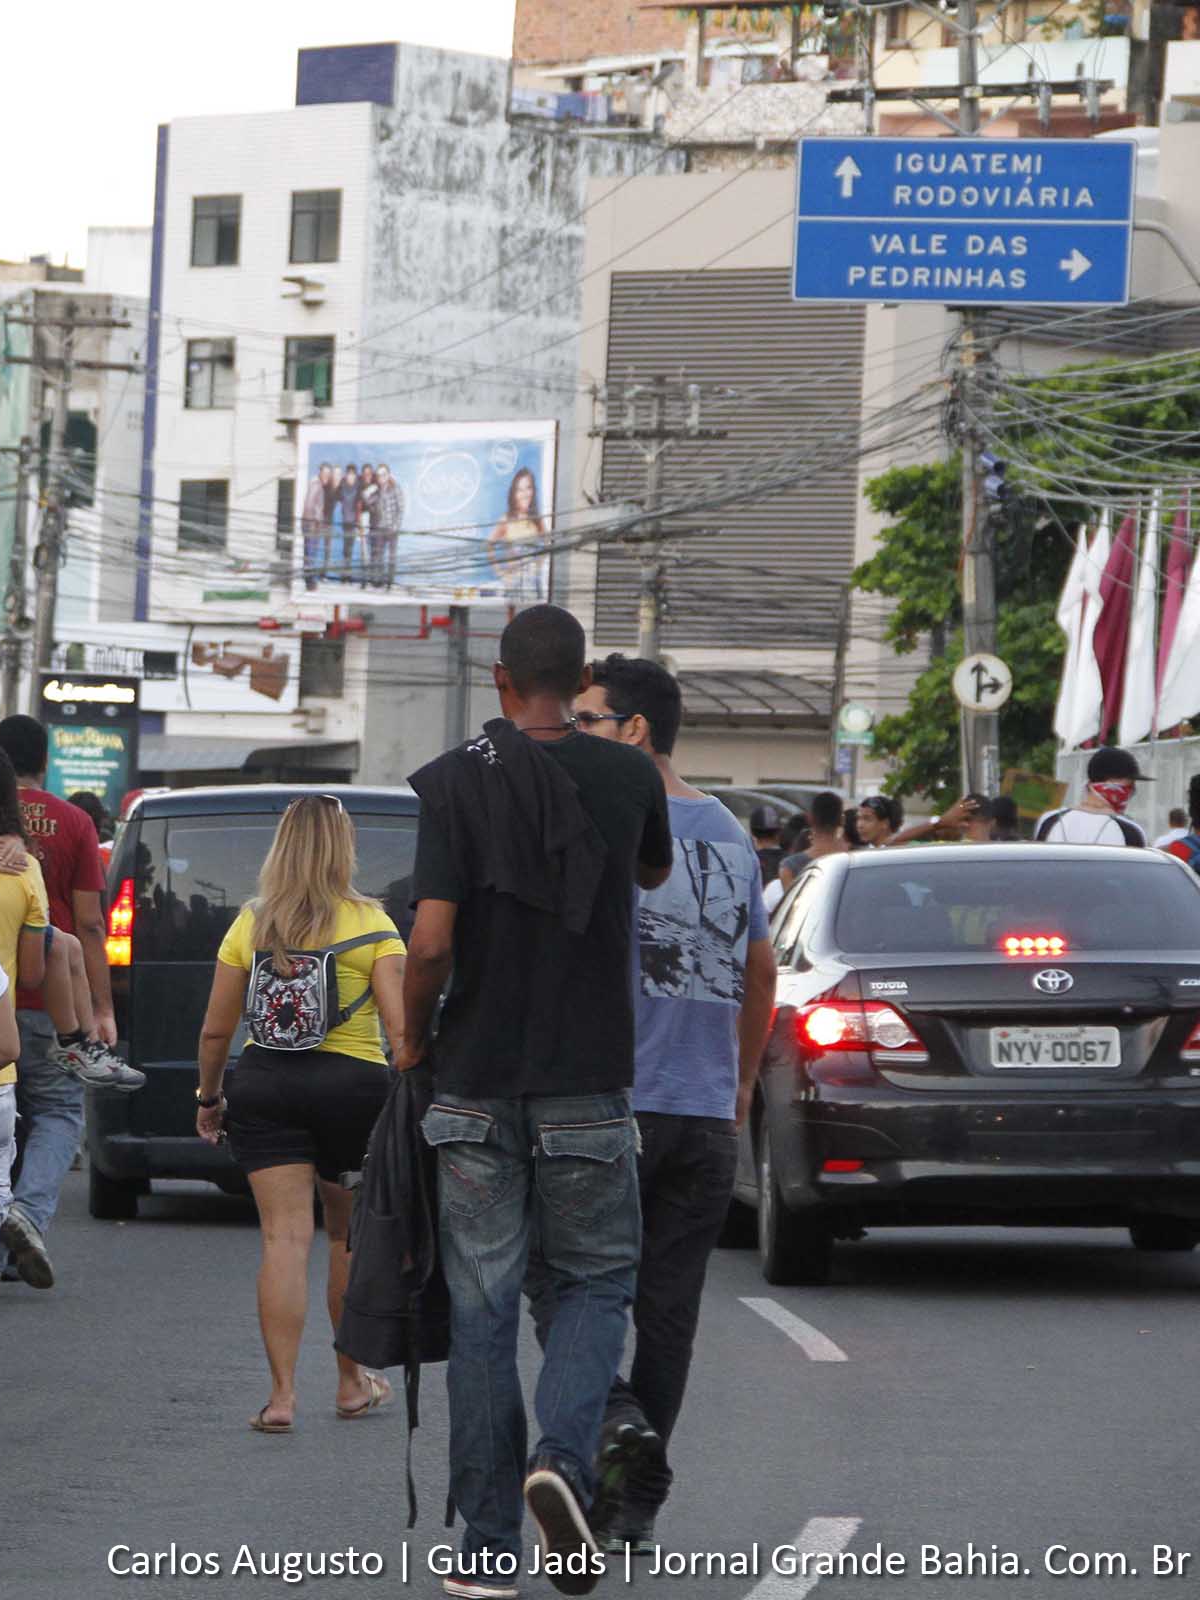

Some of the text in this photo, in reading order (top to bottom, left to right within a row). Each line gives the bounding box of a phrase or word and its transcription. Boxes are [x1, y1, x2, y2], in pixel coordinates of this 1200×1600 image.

[894, 153, 1043, 174] IGUATEMI
[894, 176, 1094, 207] RODOVIÁRIA
[870, 234, 1029, 256] VALE DAS
[848, 266, 1026, 288] PEDRINHAS
[869, 981, 908, 990] TOYOTA
[997, 1040, 1112, 1063] NYV-0067
